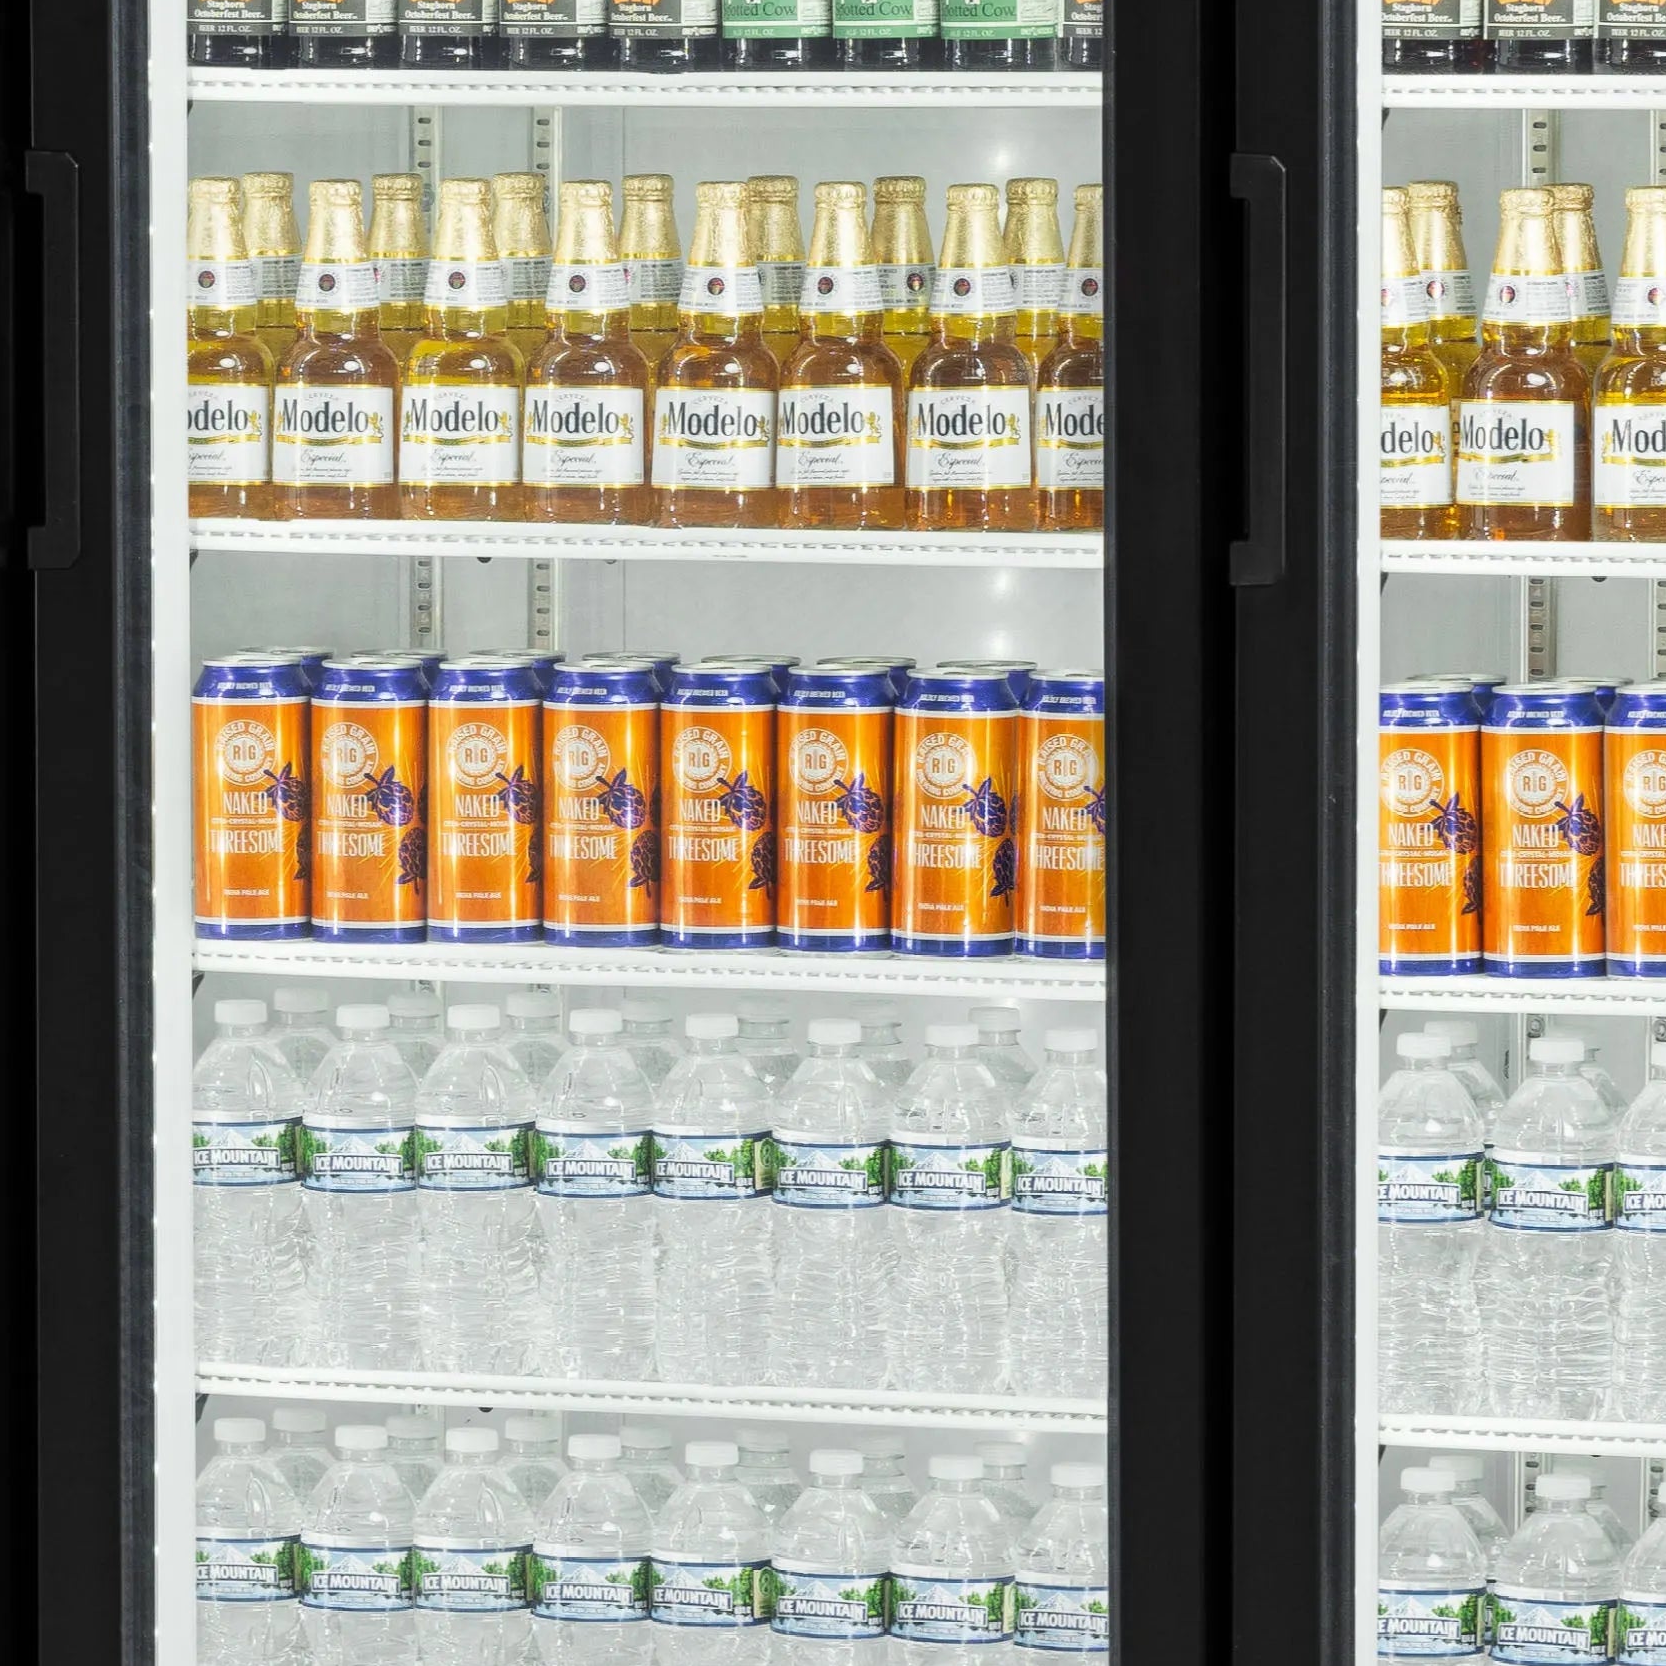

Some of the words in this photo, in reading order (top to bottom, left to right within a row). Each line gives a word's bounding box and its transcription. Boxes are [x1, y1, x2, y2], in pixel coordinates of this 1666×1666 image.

[281, 402, 370, 435] Modelo
[532, 403, 621, 435] Modelo
[667, 403, 756, 437] Modelo
[917, 404, 1006, 437] Modelo
[223, 792, 268, 814] NAKED
[678, 798, 720, 820] NAKED
[316, 1156, 331, 1171] ICE
[332, 1156, 402, 1174] MOUNTAIN
[780, 1599, 796, 1614] ICE
[797, 1600, 867, 1620] MOUNTAIN
[899, 1604, 914, 1619] ICE
[916, 1605, 987, 1625] MOUNTAIN
[1629, 1631, 1645, 1646] ICE
